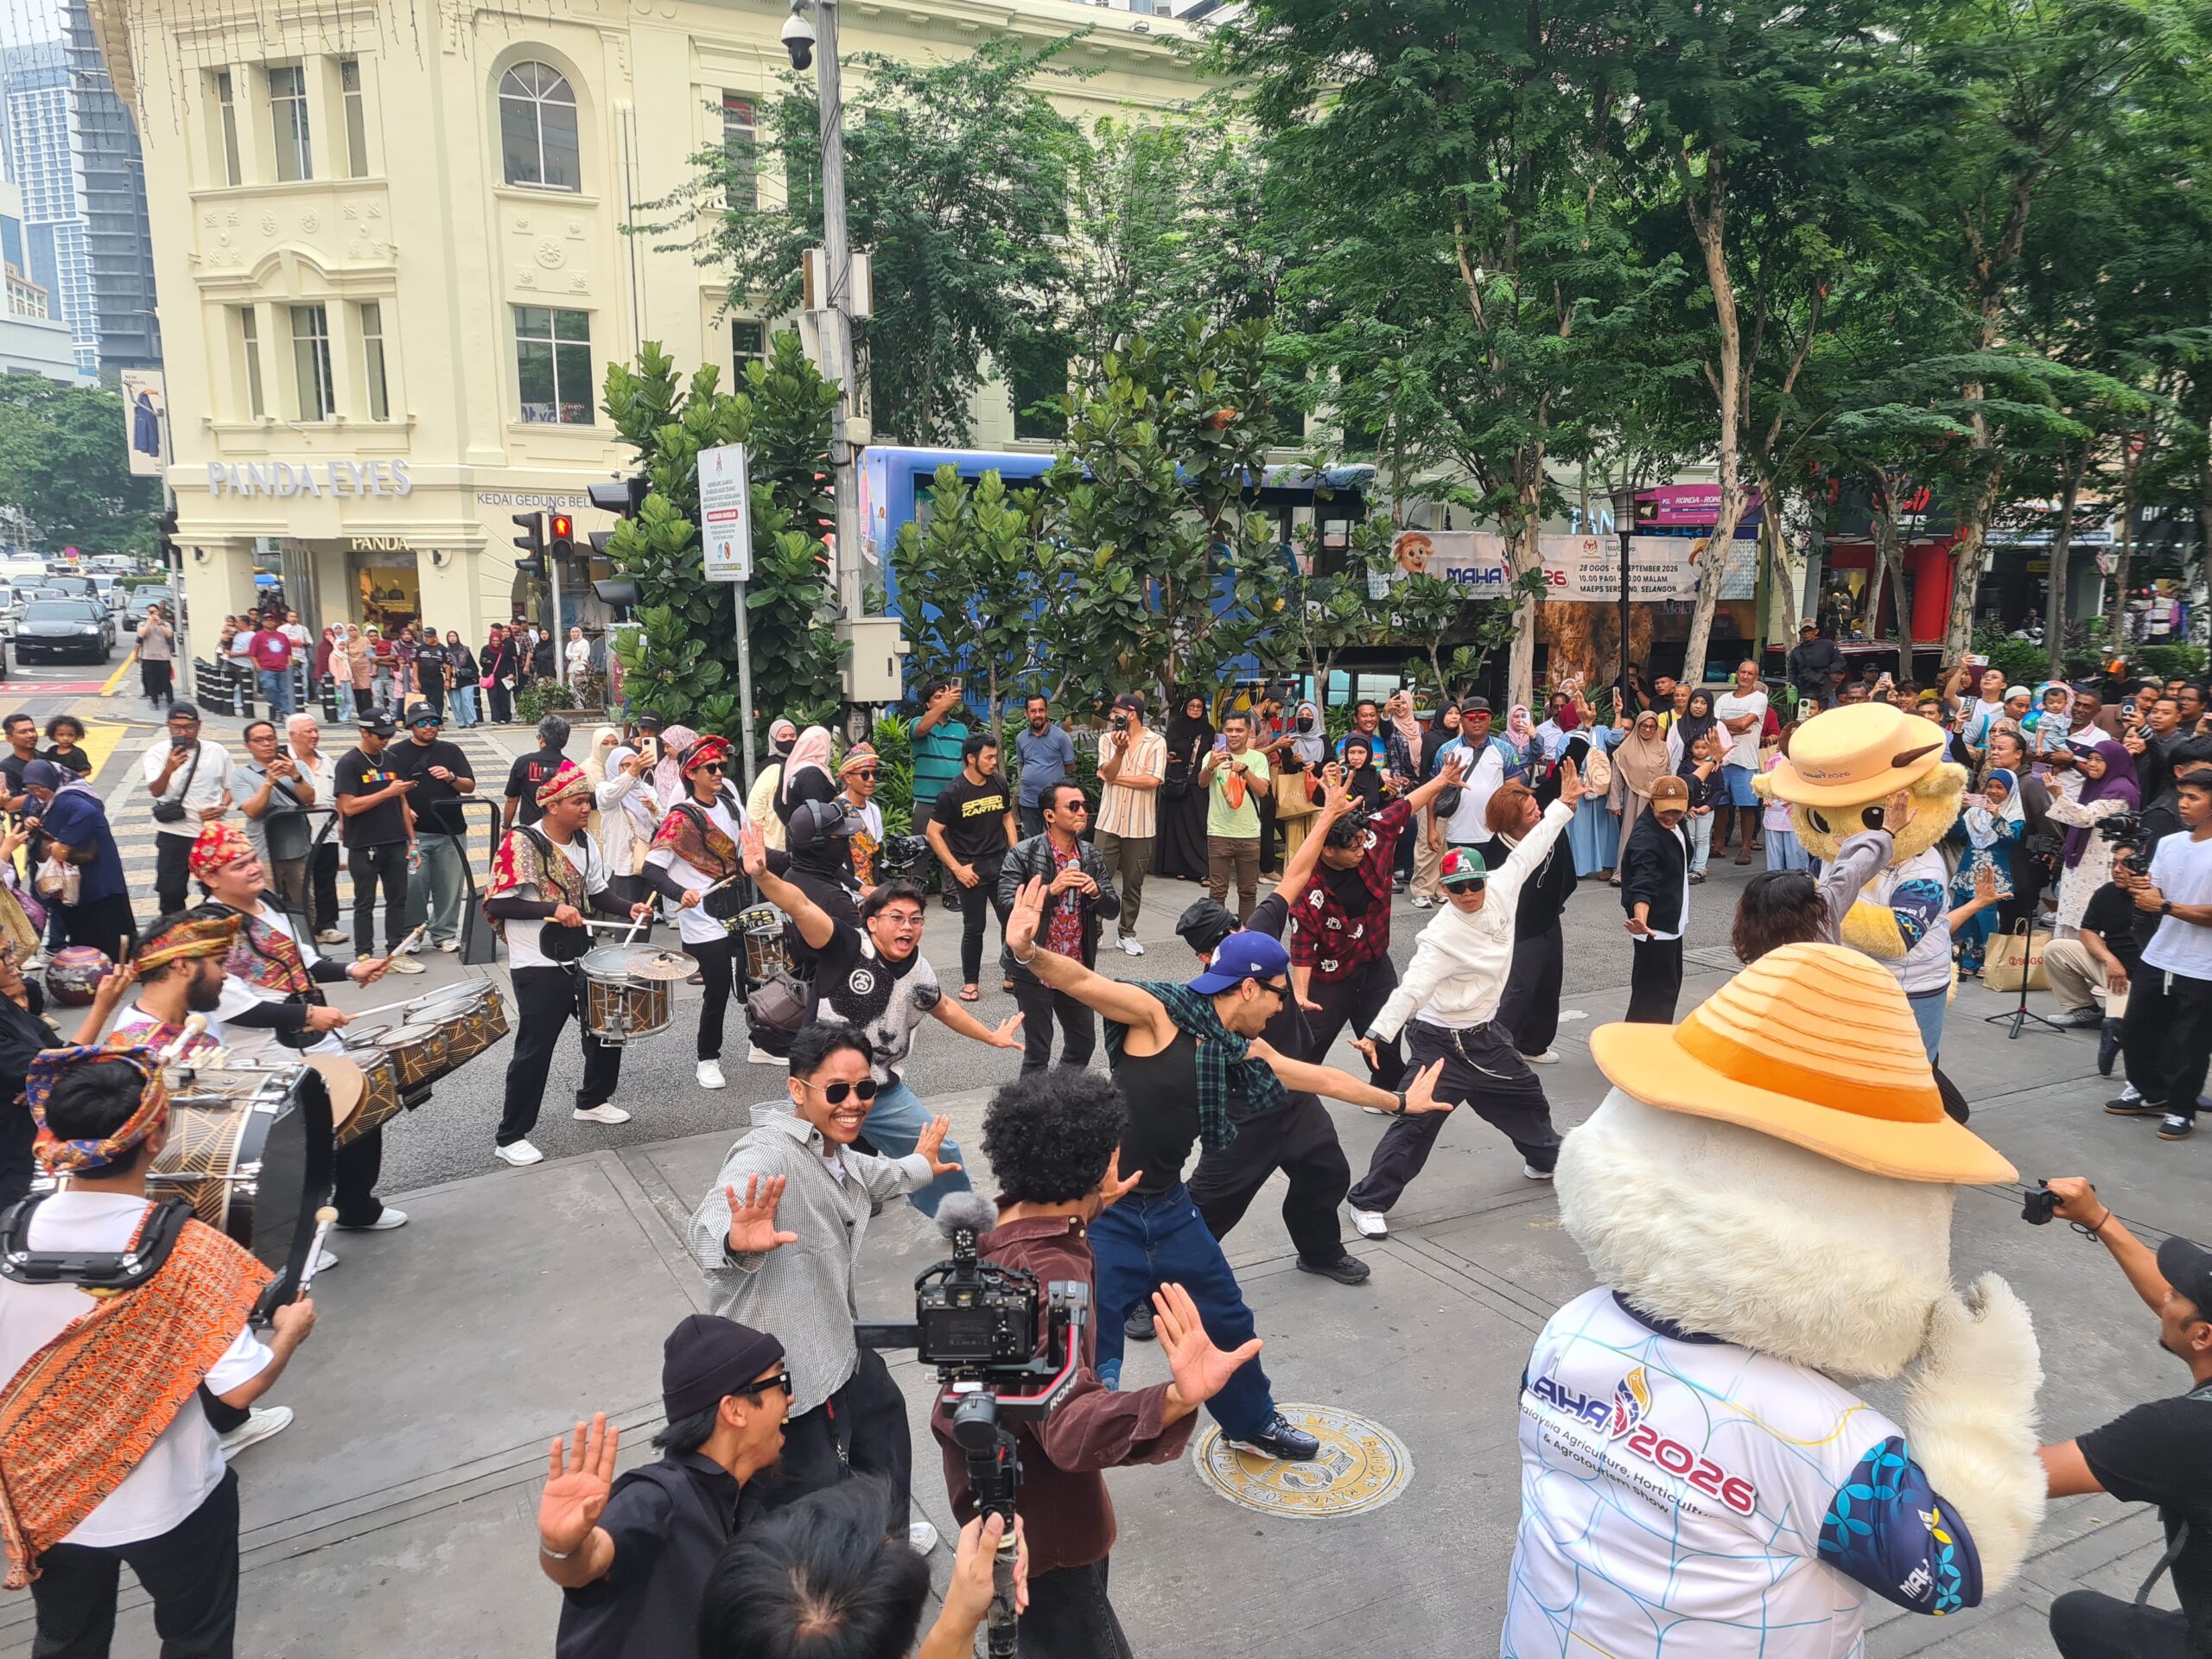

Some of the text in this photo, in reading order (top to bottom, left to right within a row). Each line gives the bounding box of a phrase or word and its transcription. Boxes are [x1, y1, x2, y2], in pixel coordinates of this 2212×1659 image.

[207, 459, 412, 497] PANDA EYES
[477, 493, 512, 505] KEDAI
[516, 494, 566, 507] GEDUNG
[351, 537, 410, 551] PANDA
[1446, 568, 1567, 585] MAHA 26
[962, 795, 1002, 811] SPEED
[2018, 957, 2044, 966] SGO
[1520, 1403, 1561, 1434] alaysia
[1531, 1376, 1756, 1514] AHA 2026
[1543, 1433, 1551, 1445] &
[1554, 1440, 1631, 1491] Agrotourism
